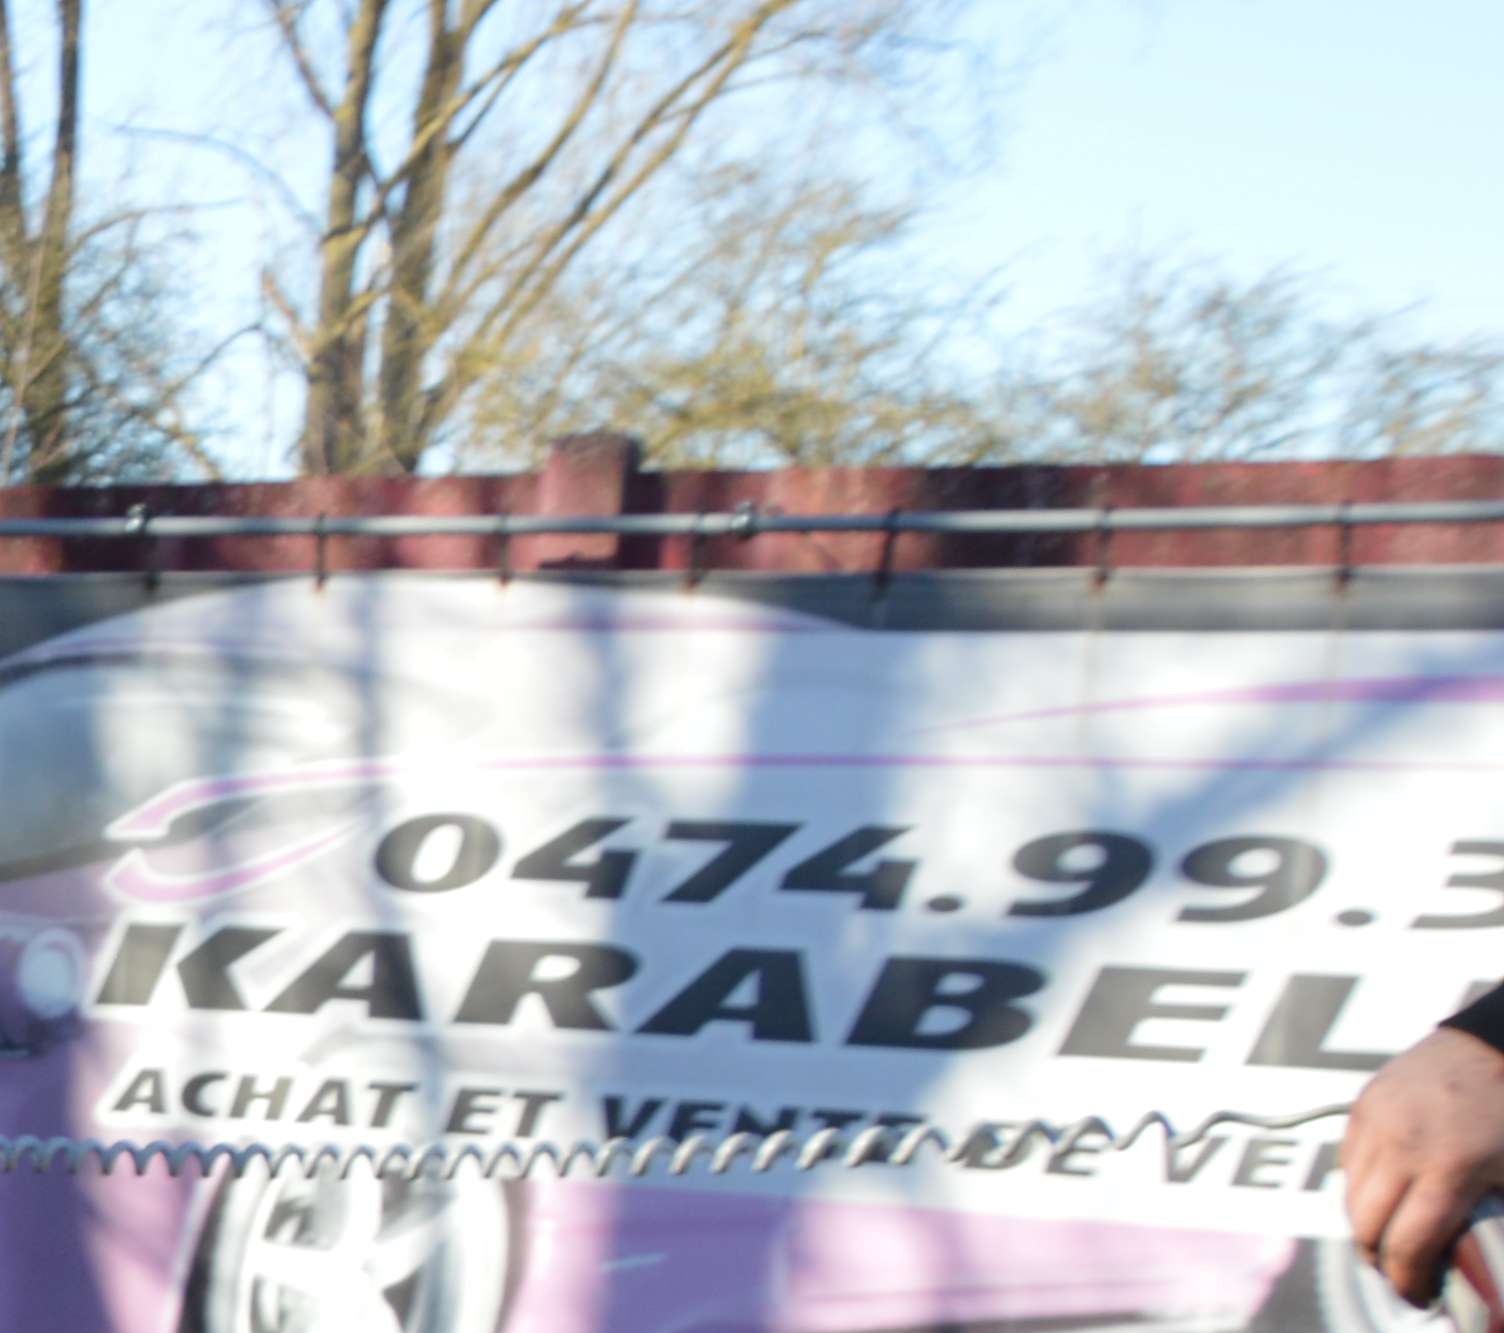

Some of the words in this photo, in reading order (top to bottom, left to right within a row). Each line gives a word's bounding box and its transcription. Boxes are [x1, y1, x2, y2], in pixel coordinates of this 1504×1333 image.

[95, 924, 1504, 1072] KARABEL
[109, 1069, 419, 1130] ACHAT
[443, 1088, 567, 1137] ET
